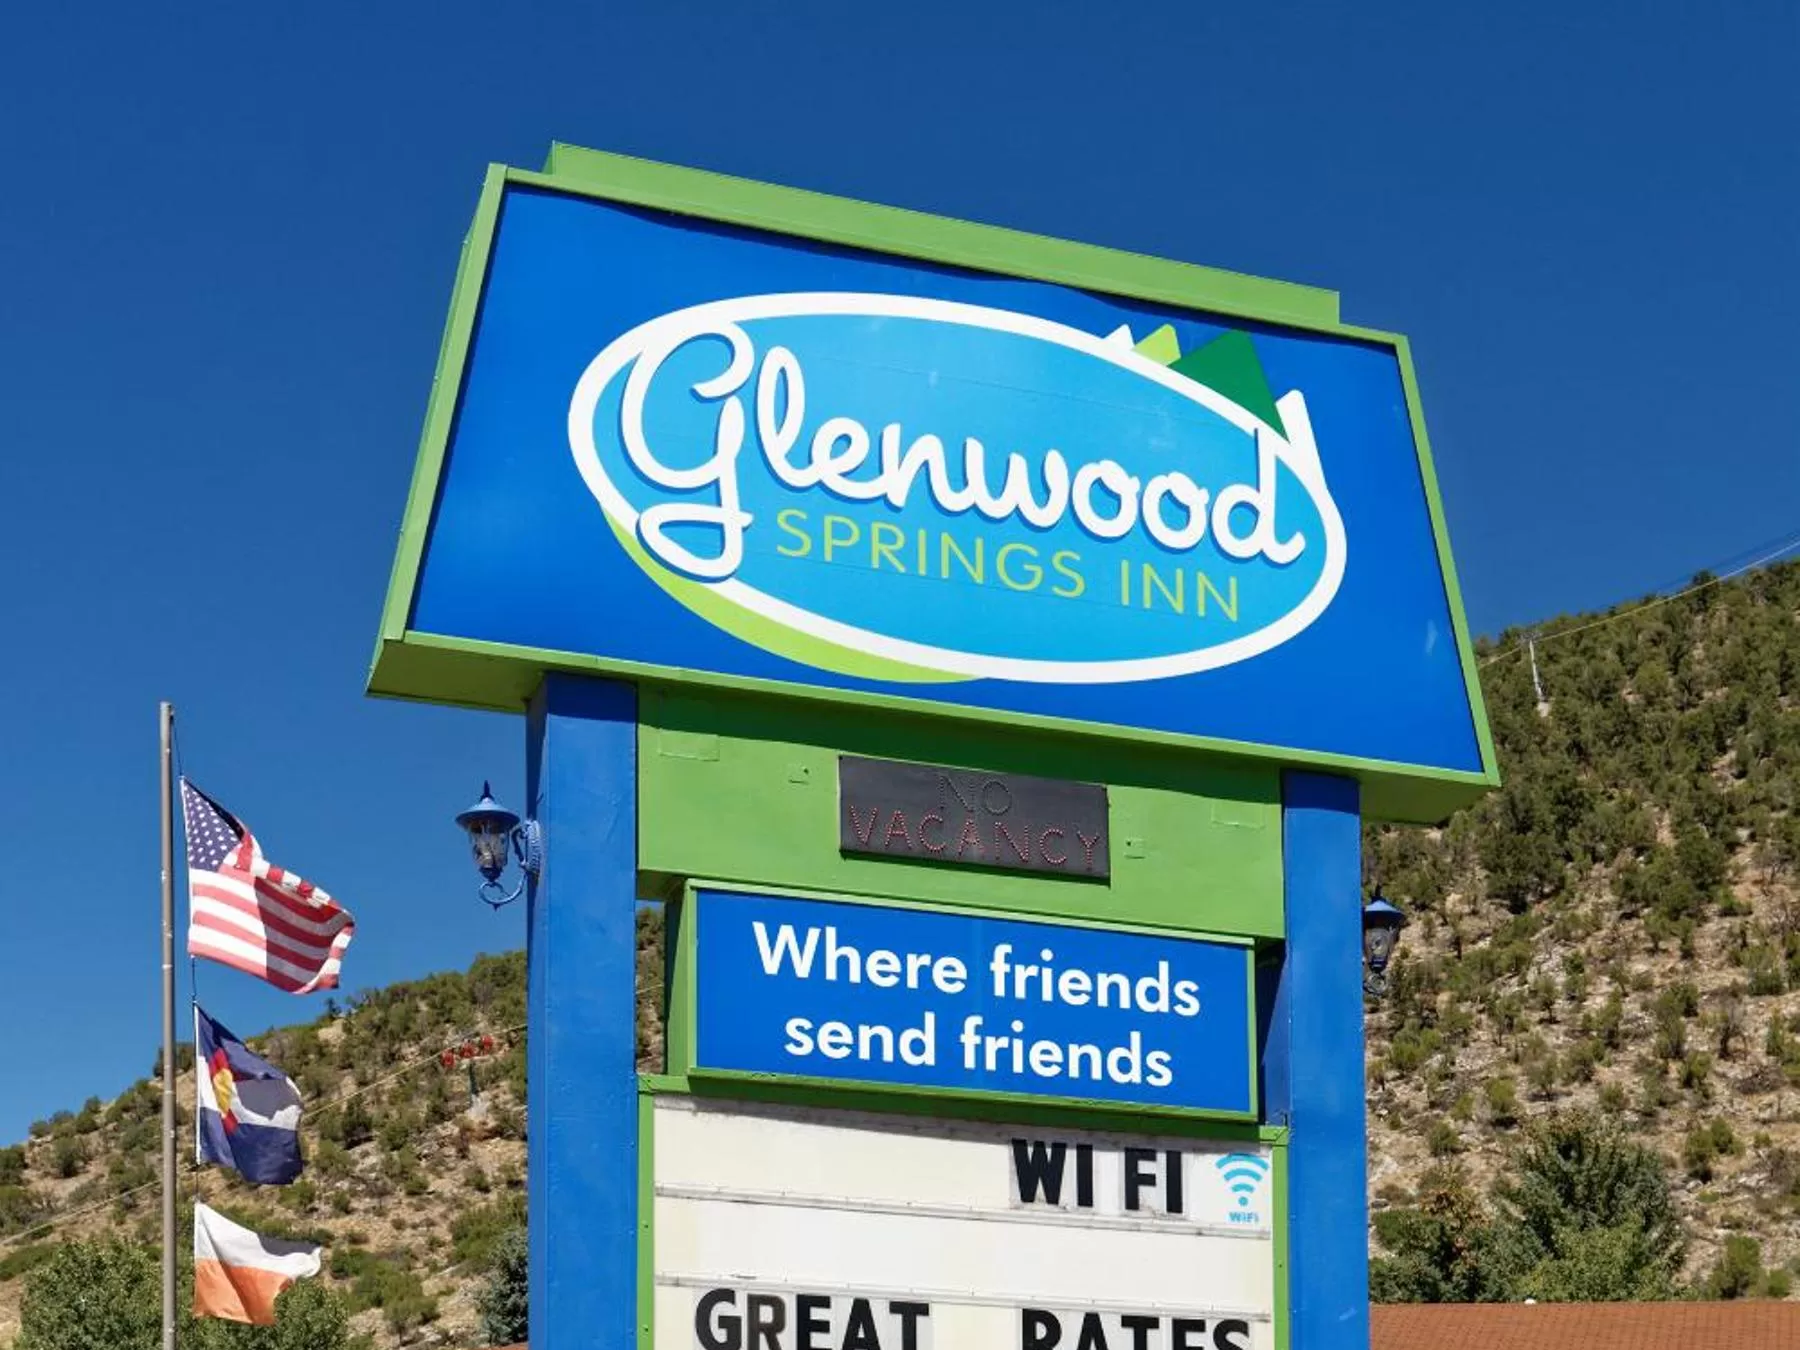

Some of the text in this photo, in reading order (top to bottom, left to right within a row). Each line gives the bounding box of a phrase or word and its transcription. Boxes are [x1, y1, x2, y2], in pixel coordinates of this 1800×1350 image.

[621, 320, 1306, 577] Glenwood
[776, 508, 1238, 622] SPRINGS INN
[850, 804, 1101, 872] VACANCY
[939, 774, 1013, 817] NO
[752, 920, 1201, 1017] Where friends
[784, 1011, 1173, 1088] send friends
